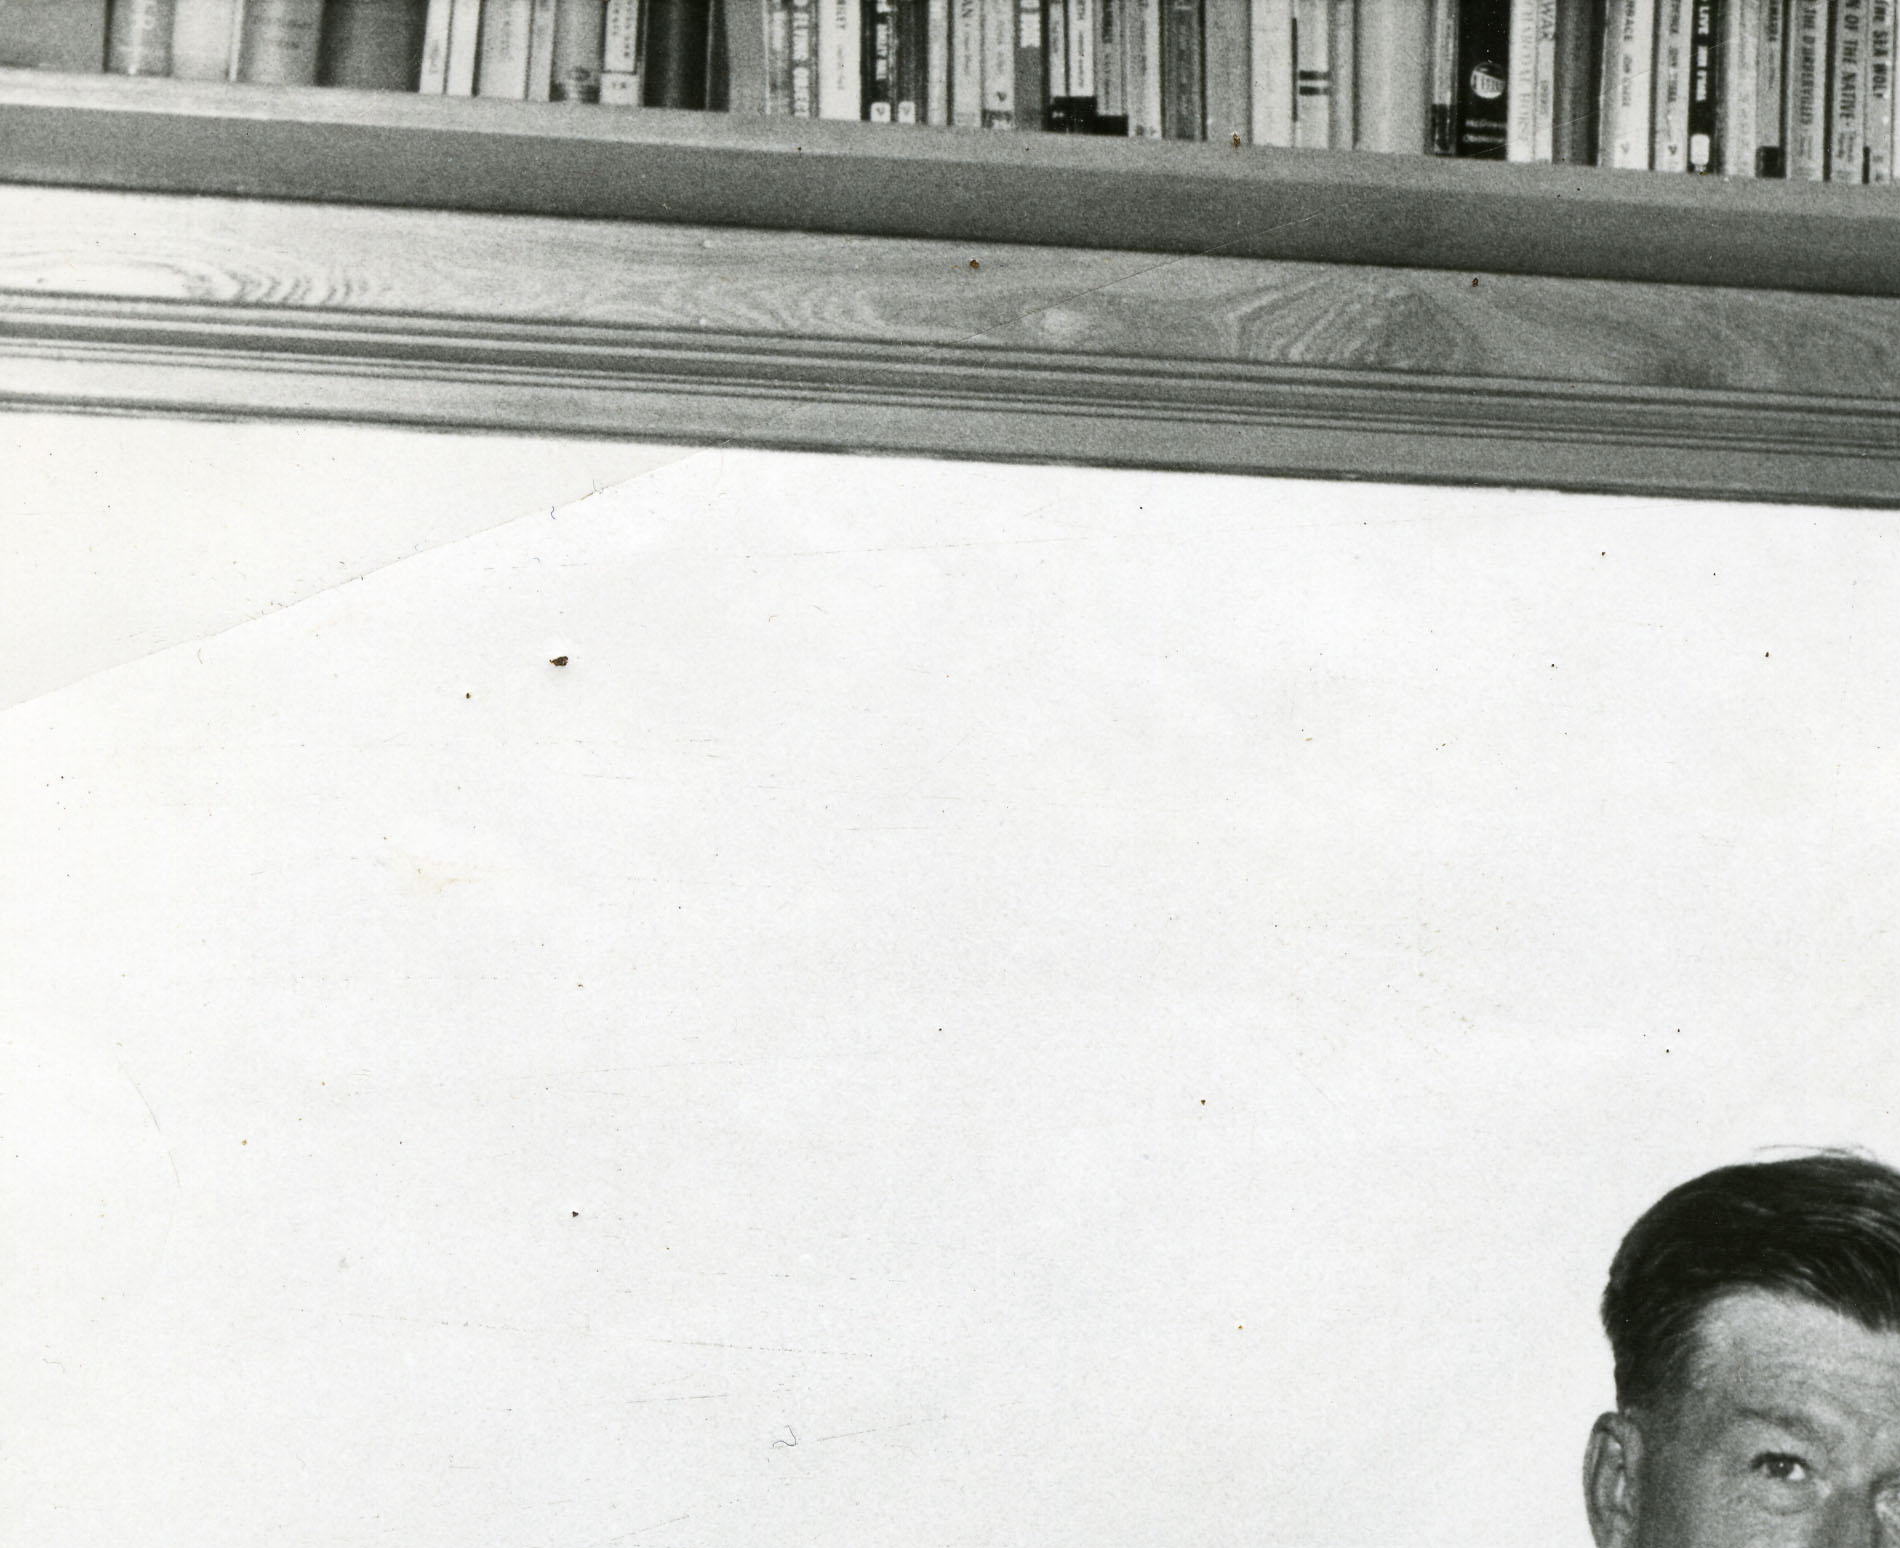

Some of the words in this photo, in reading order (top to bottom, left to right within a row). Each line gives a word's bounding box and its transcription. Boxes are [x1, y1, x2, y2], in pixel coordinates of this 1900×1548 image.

[1842, 39, 1858, 64] THE
[1872, 30, 1889, 57] SEA
[1839, 71, 1858, 119] NATIVE
[1872, 63, 1888, 98] WOLF
